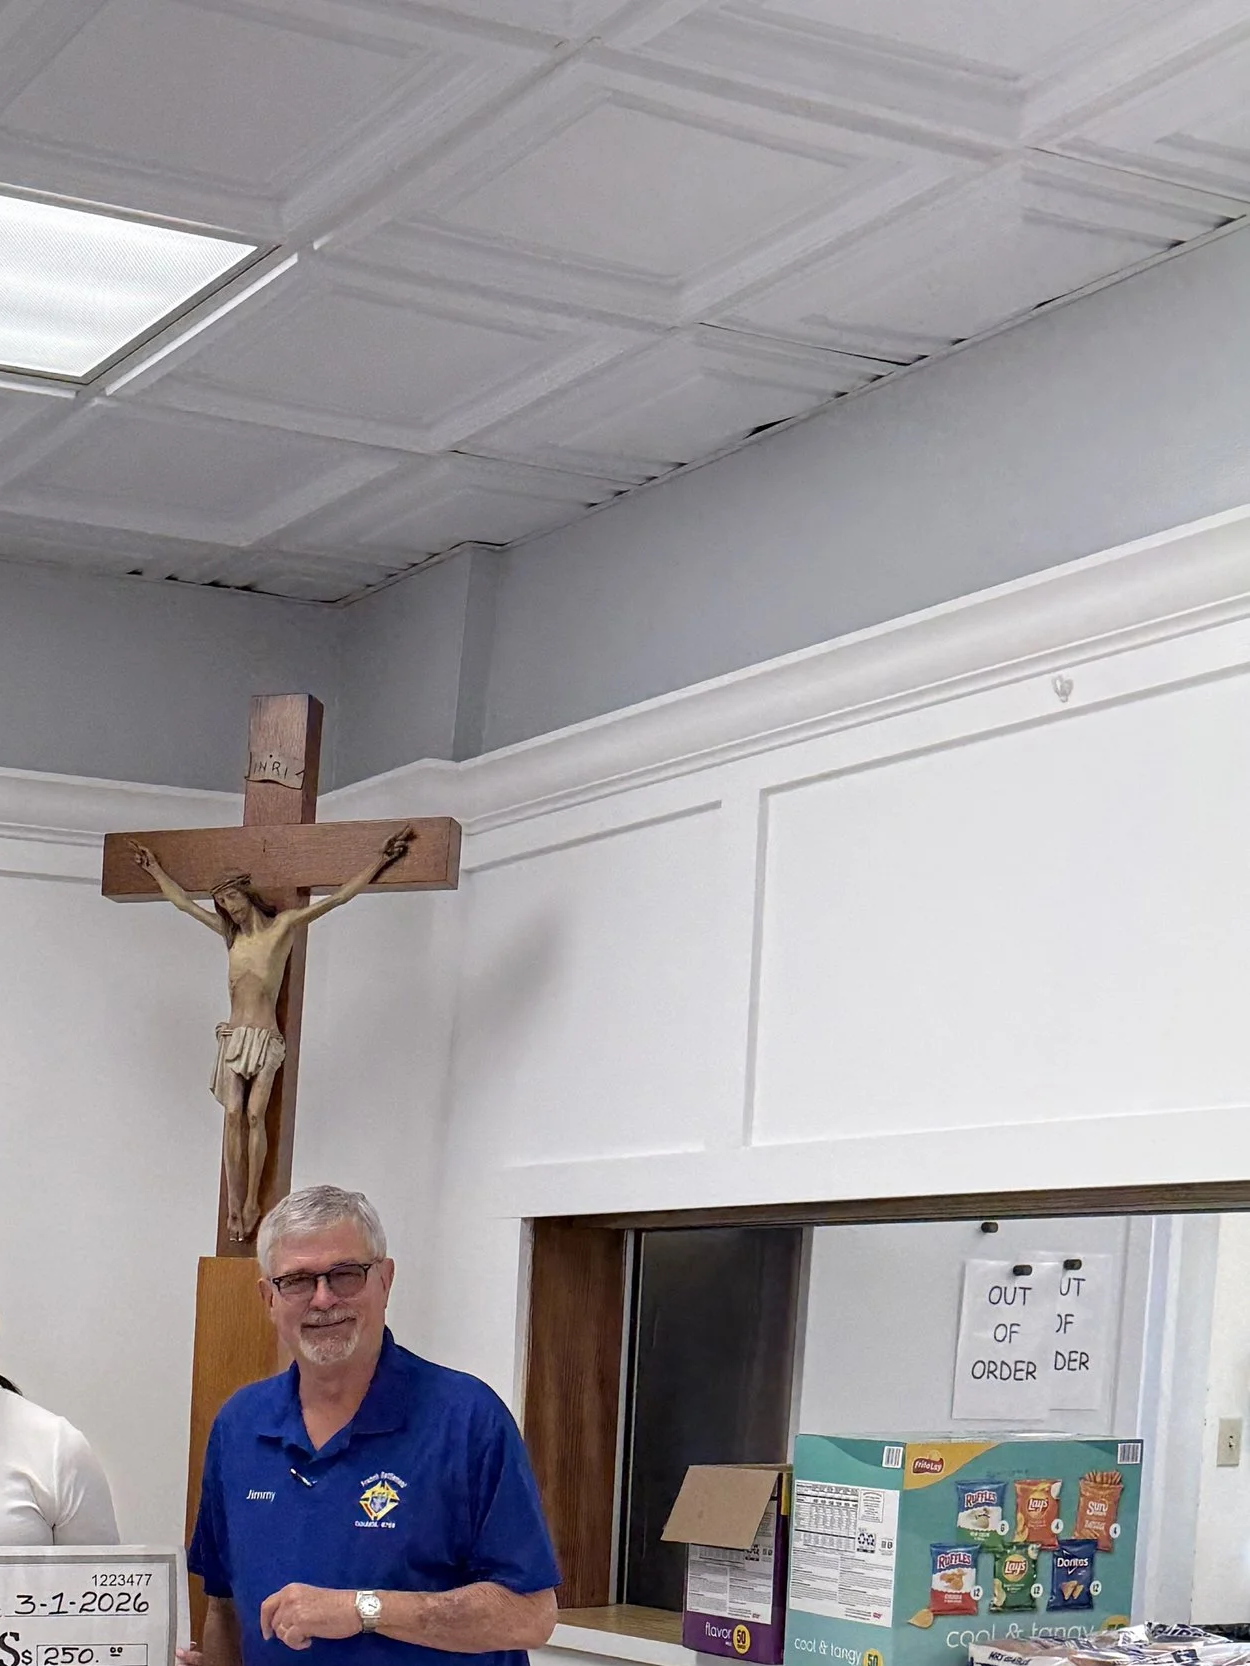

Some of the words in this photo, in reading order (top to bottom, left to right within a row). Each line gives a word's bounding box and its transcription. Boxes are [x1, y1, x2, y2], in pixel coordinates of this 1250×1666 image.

[253, 761, 288, 779] INRI
[988, 1285, 1033, 1306] OUT
[1060, 1277, 1086, 1297] UT
[993, 1323, 1021, 1344] OF
[1054, 1350, 1090, 1371] DER
[971, 1360, 1037, 1381] ORDER
[246, 1489, 276, 1502] Jimmy
[937, 1552, 972, 1569] RUFFLES
[1057, 1557, 1089, 1568] Doritos
[91, 1573, 153, 1587] 1223477
[14, 1591, 150, 1615] 3-1-2026
[705, 1621, 732, 1639] flavor
[736, 1629, 747, 1645] 50
[794, 1638, 816, 1653] cool
[830, 1643, 862, 1666] tangy
